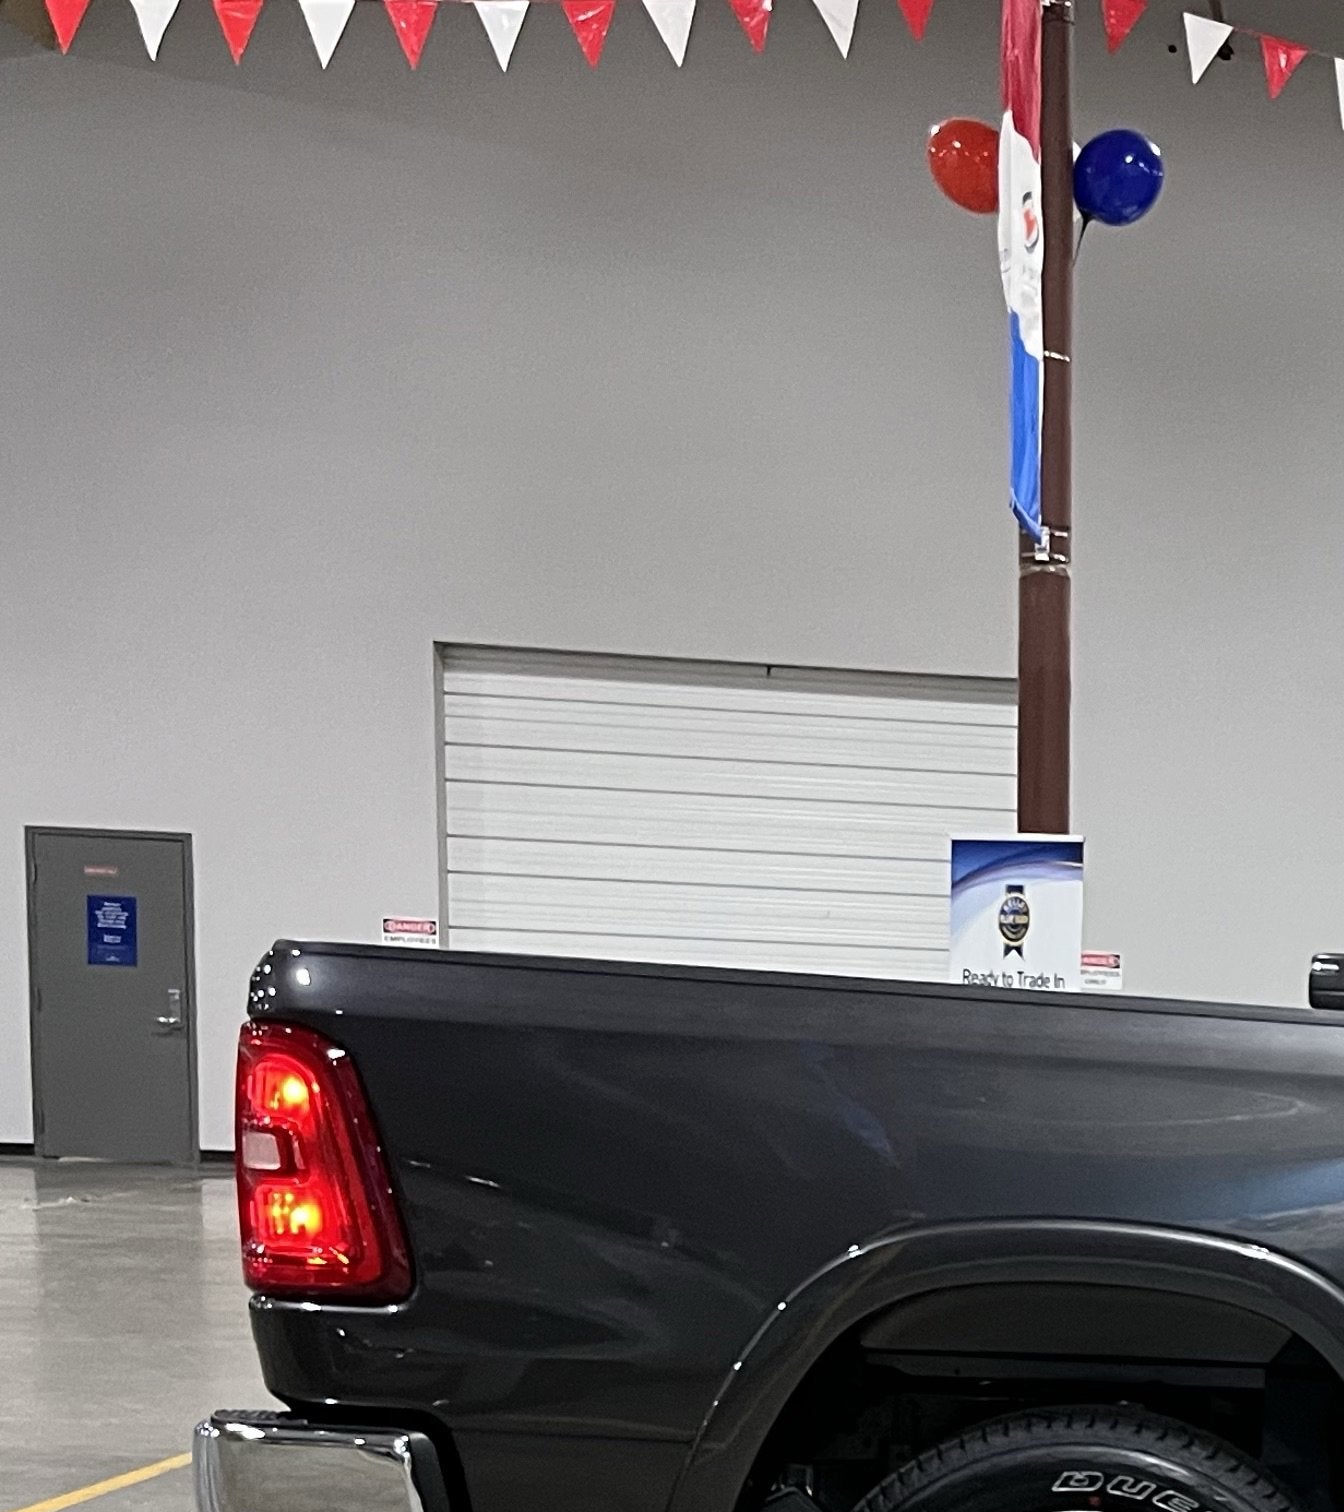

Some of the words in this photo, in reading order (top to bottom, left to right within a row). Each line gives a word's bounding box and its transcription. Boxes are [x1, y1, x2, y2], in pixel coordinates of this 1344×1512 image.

[962, 969, 999, 987] Ready
[1002, 974, 1014, 988] to
[1017, 970, 1050, 988] Trade
[1054, 973, 1066, 989] In
